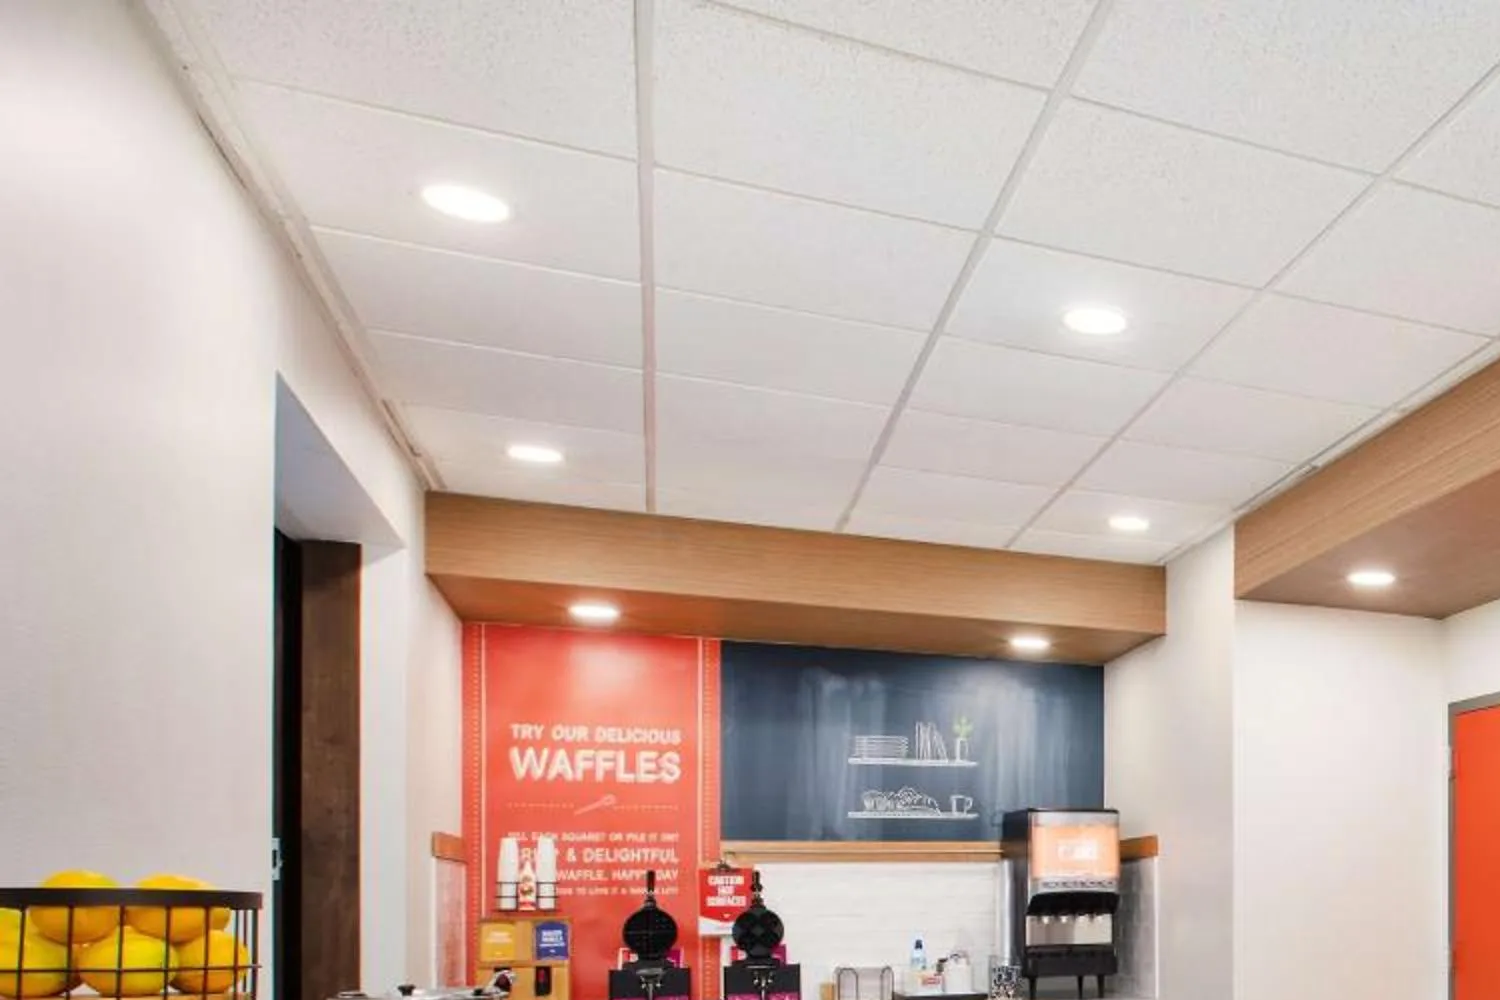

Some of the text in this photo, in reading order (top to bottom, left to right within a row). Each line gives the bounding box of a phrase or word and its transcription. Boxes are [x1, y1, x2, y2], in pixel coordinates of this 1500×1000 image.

[510, 723, 682, 744] TRY OUR DELICIOUS
[509, 746, 682, 784] WAFFLES
[583, 847, 680, 864] DELIGHTFUL
[655, 869, 679, 881] DAY
